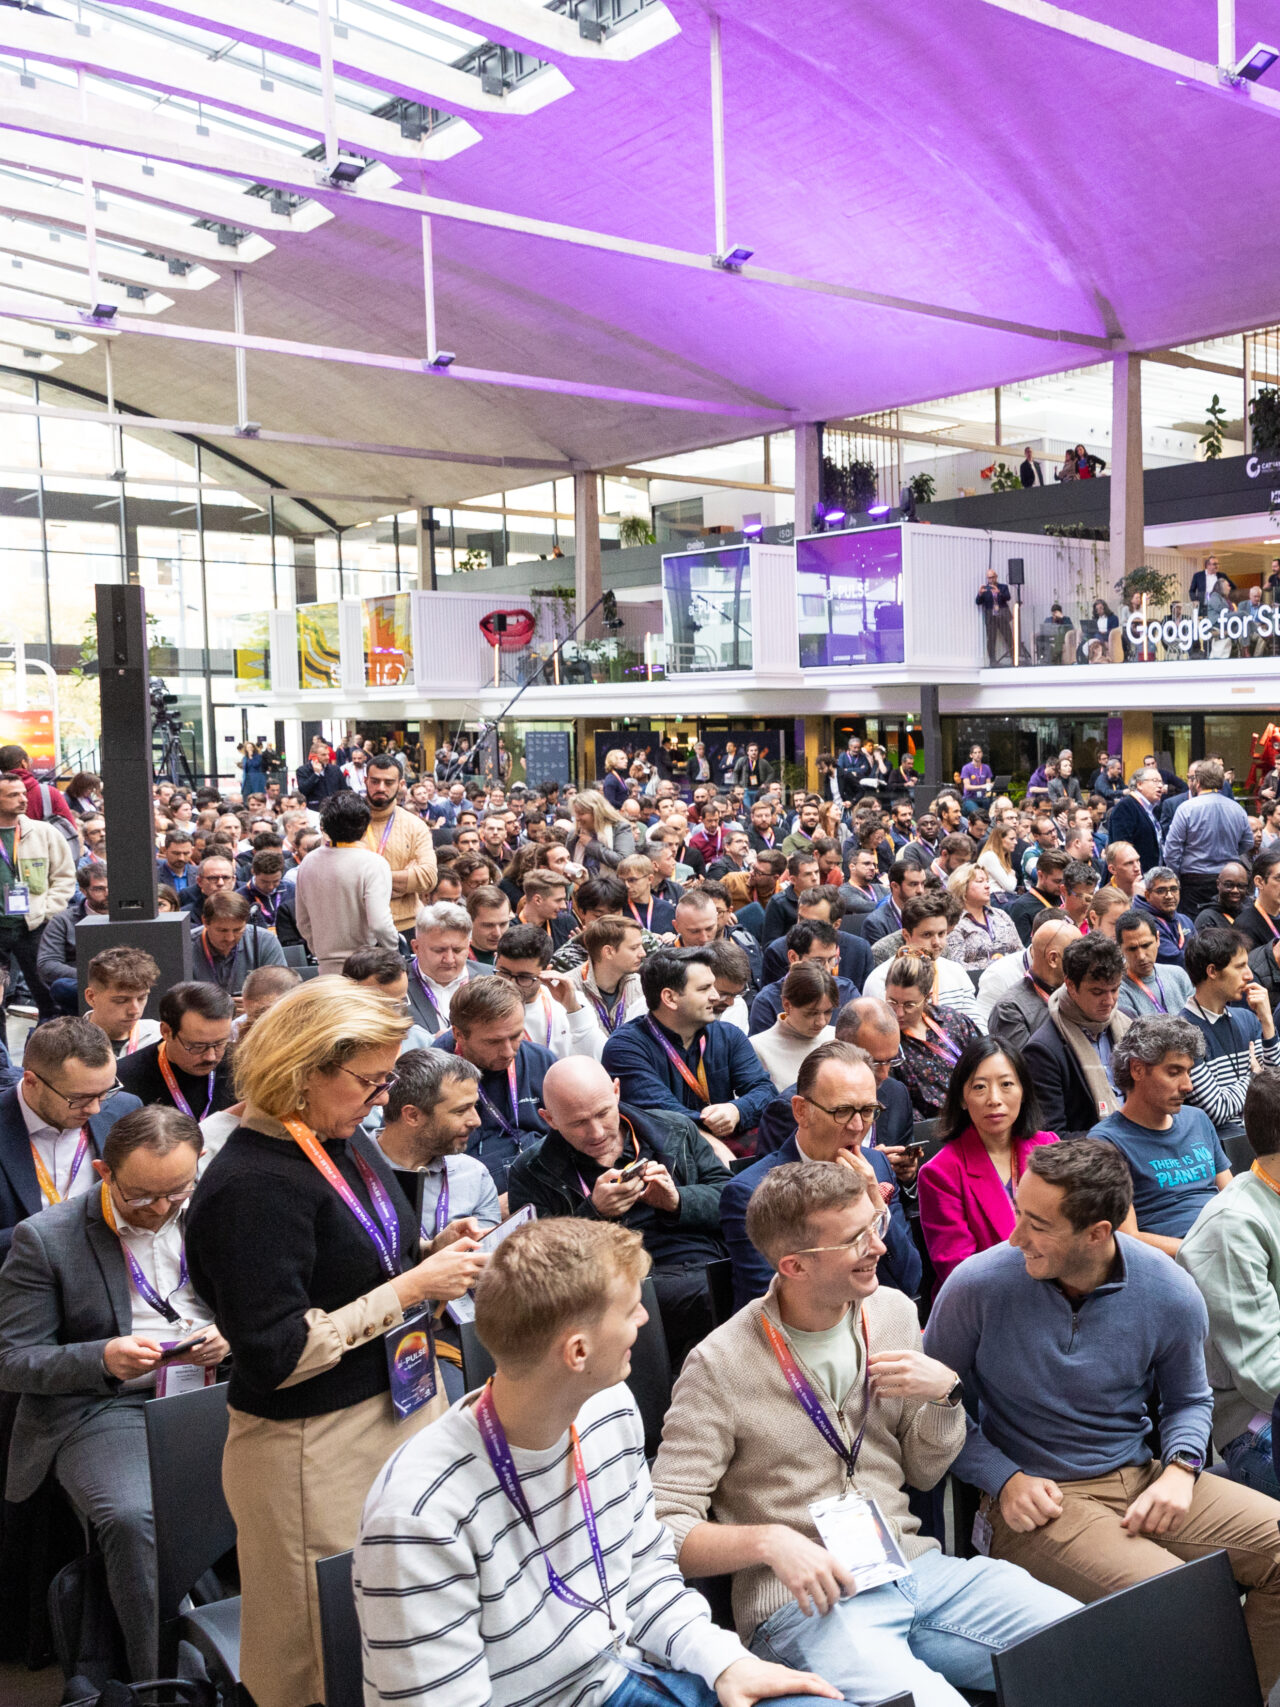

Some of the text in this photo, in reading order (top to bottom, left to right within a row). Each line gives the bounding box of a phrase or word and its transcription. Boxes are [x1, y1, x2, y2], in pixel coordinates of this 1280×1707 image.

[1126, 609, 1212, 650] Google
[1220, 608, 1252, 639] for
[1148, 1146, 1212, 1171] THERE IS NO
[1156, 1164, 1206, 1188] PLANET
